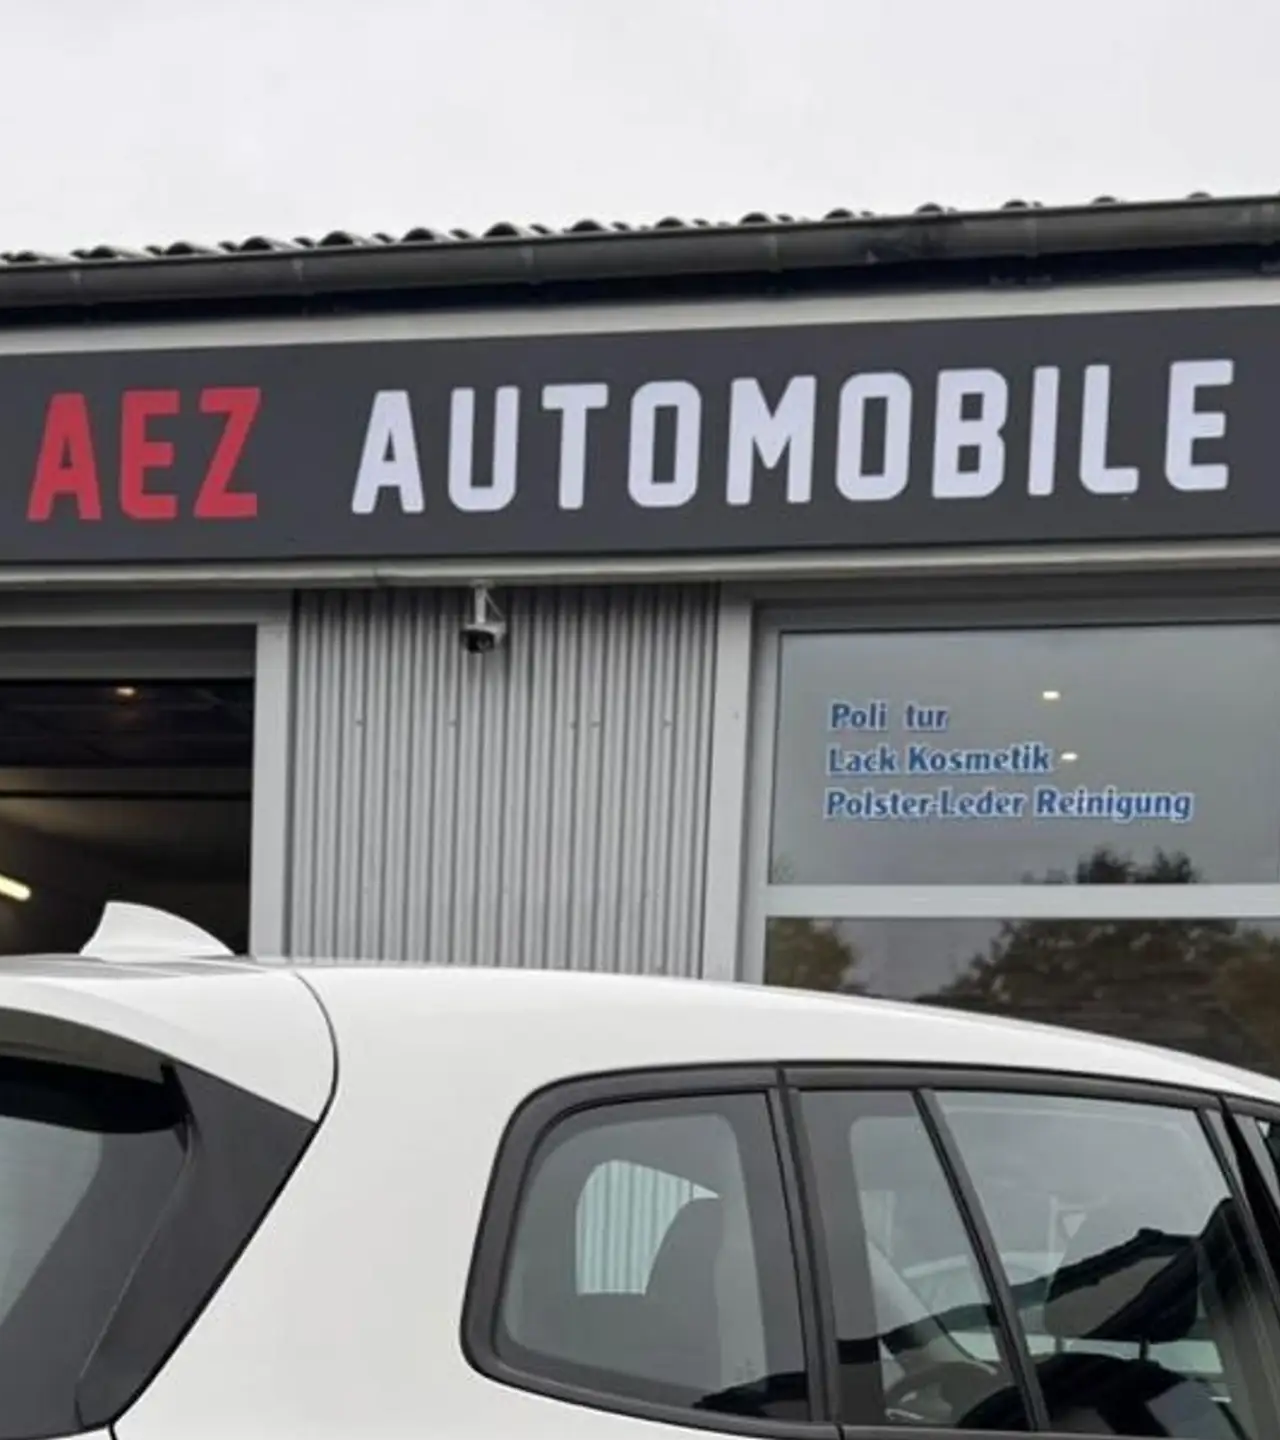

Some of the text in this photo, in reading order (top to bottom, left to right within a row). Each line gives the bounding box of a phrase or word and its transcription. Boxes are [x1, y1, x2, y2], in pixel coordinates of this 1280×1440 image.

[26, 358, 1235, 523] AEZ AUTOMOBILE
[827, 743, 1053, 774] Lack Kosmetik
[1034, 786, 1194, 821] Reinigung
